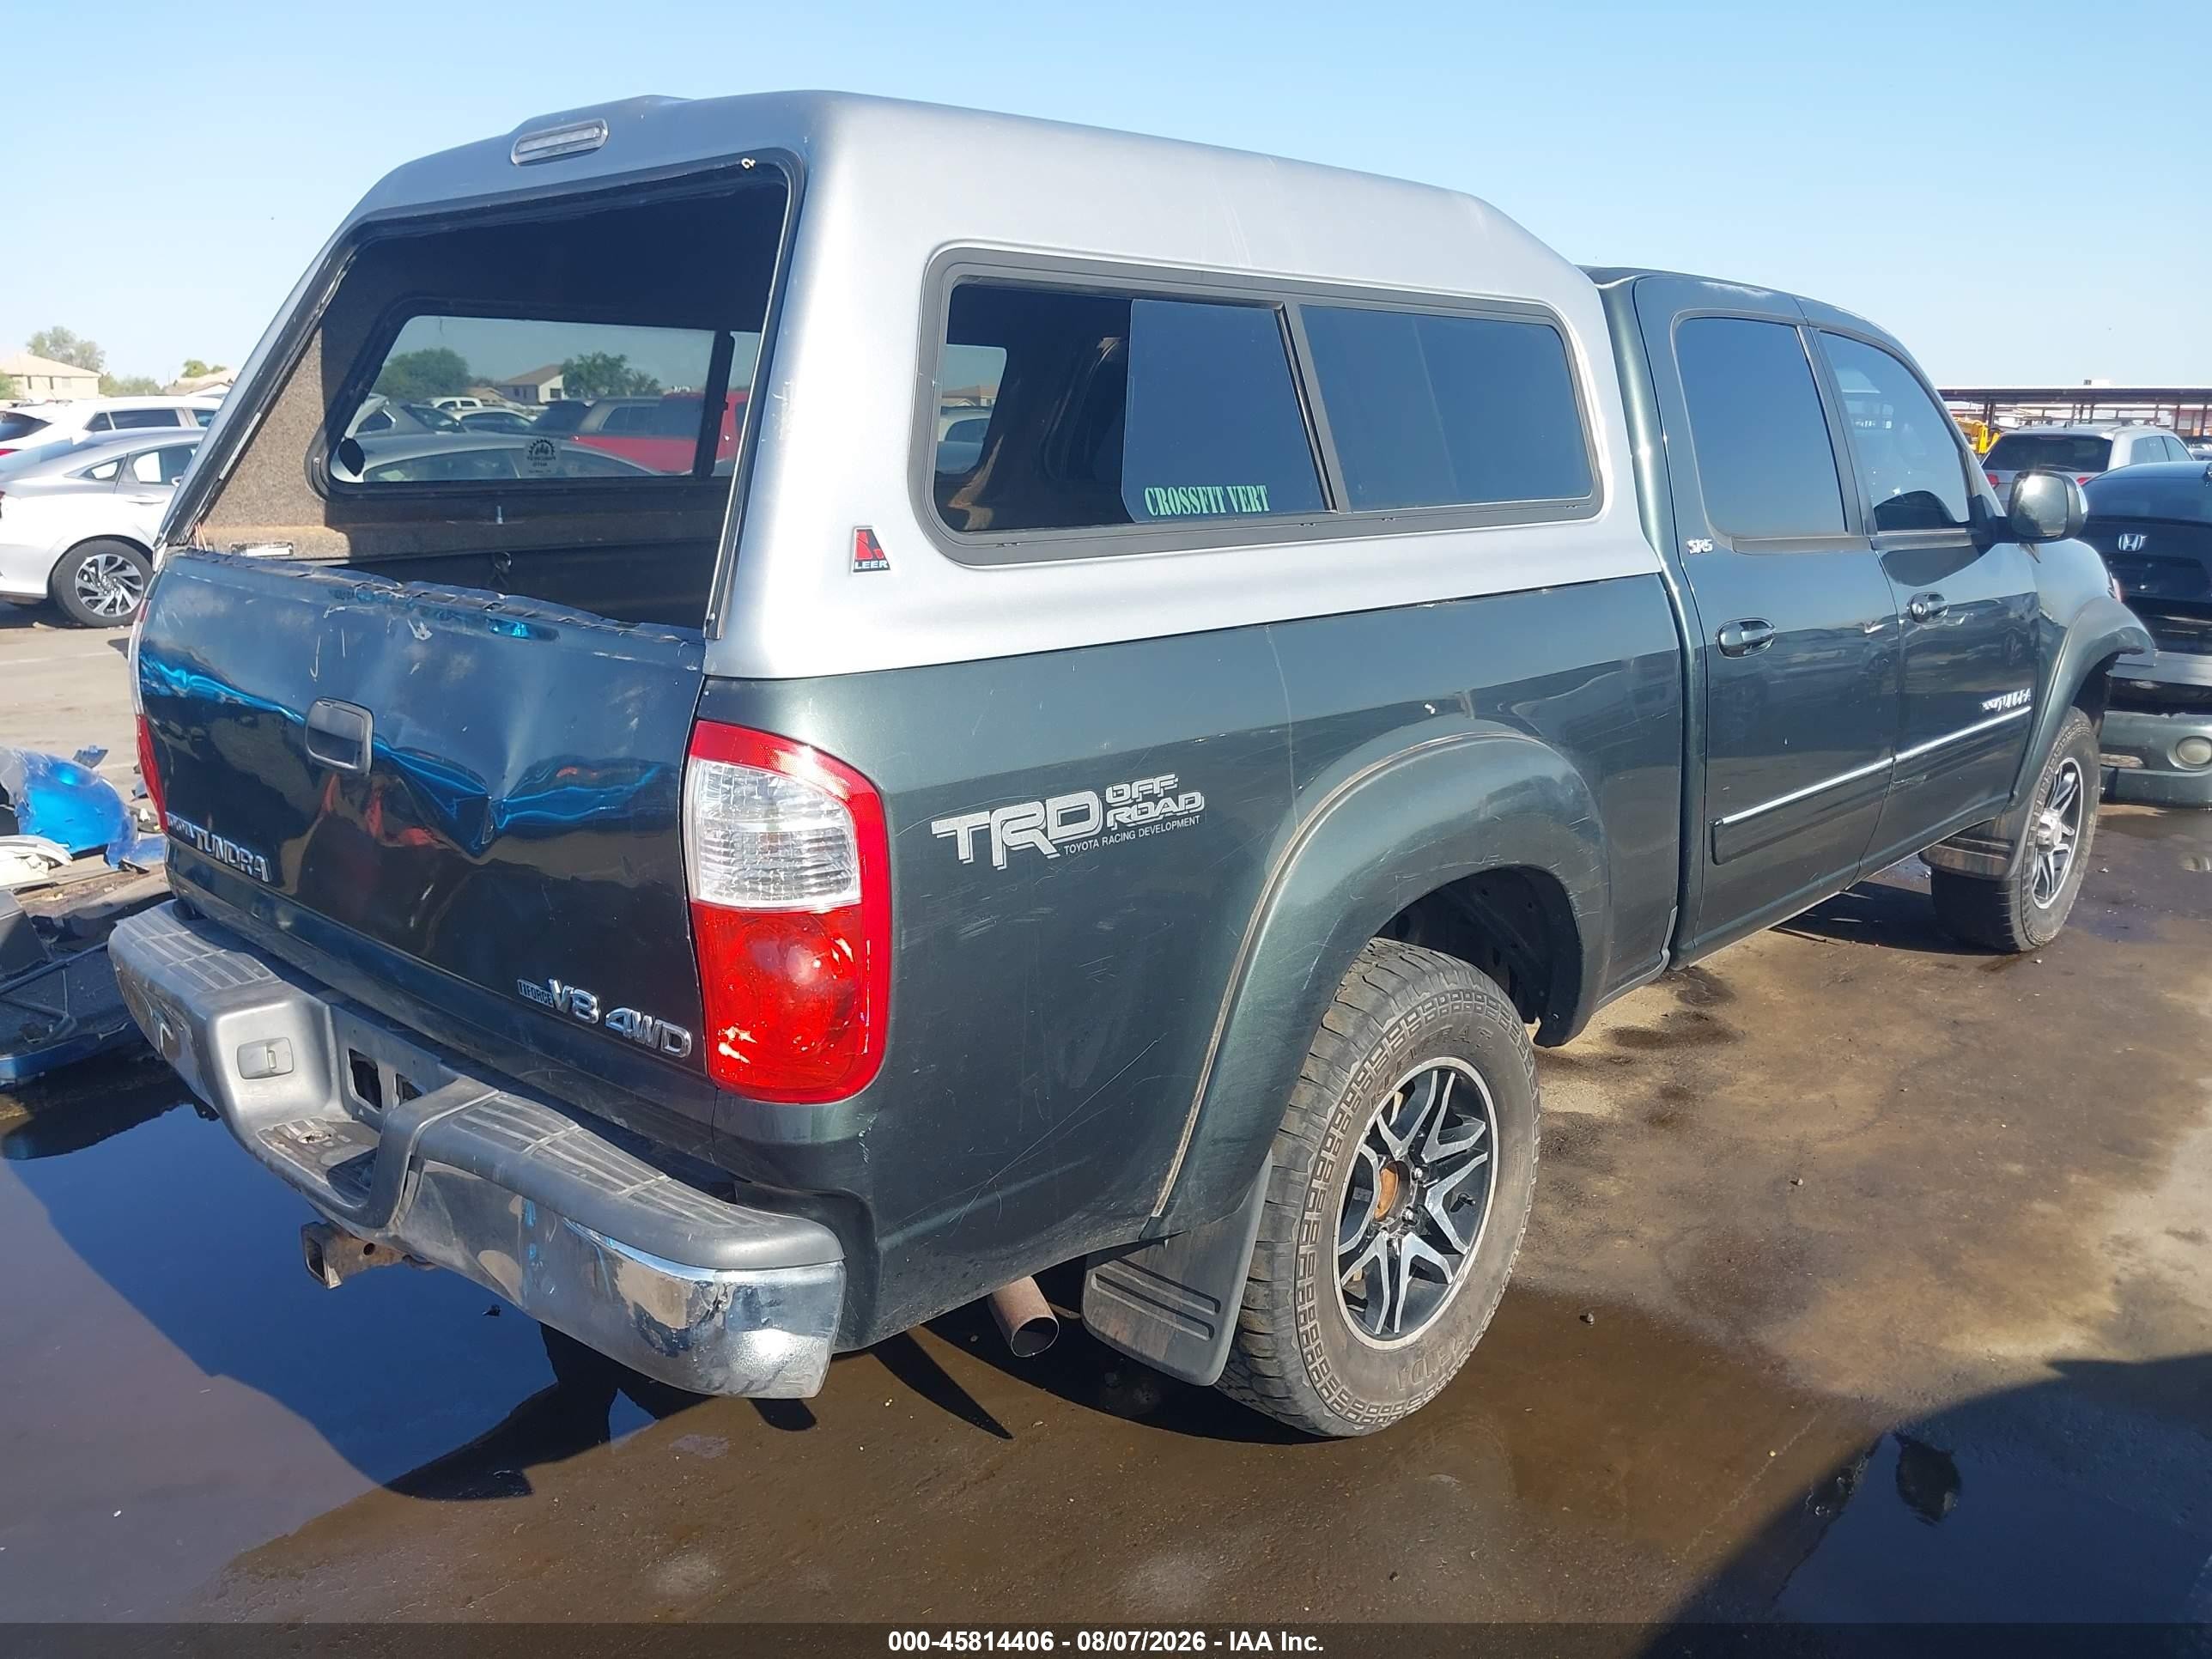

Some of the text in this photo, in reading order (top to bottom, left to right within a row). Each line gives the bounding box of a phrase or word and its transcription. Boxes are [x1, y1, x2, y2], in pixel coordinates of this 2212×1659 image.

[1145, 485, 1270, 516] CROSSFIT VERT
[854, 560, 889, 569] LEER
[1105, 774, 1179, 805] OFF
[931, 790, 1103, 870] TRD
[1106, 791, 1205, 831] ROAD
[192, 824, 270, 883] TUNDRA
[1064, 815, 1200, 855] TOYOTA RACING DEVELOPMENT
[548, 978, 600, 1024] V8
[605, 1007, 693, 1059] 4WD
